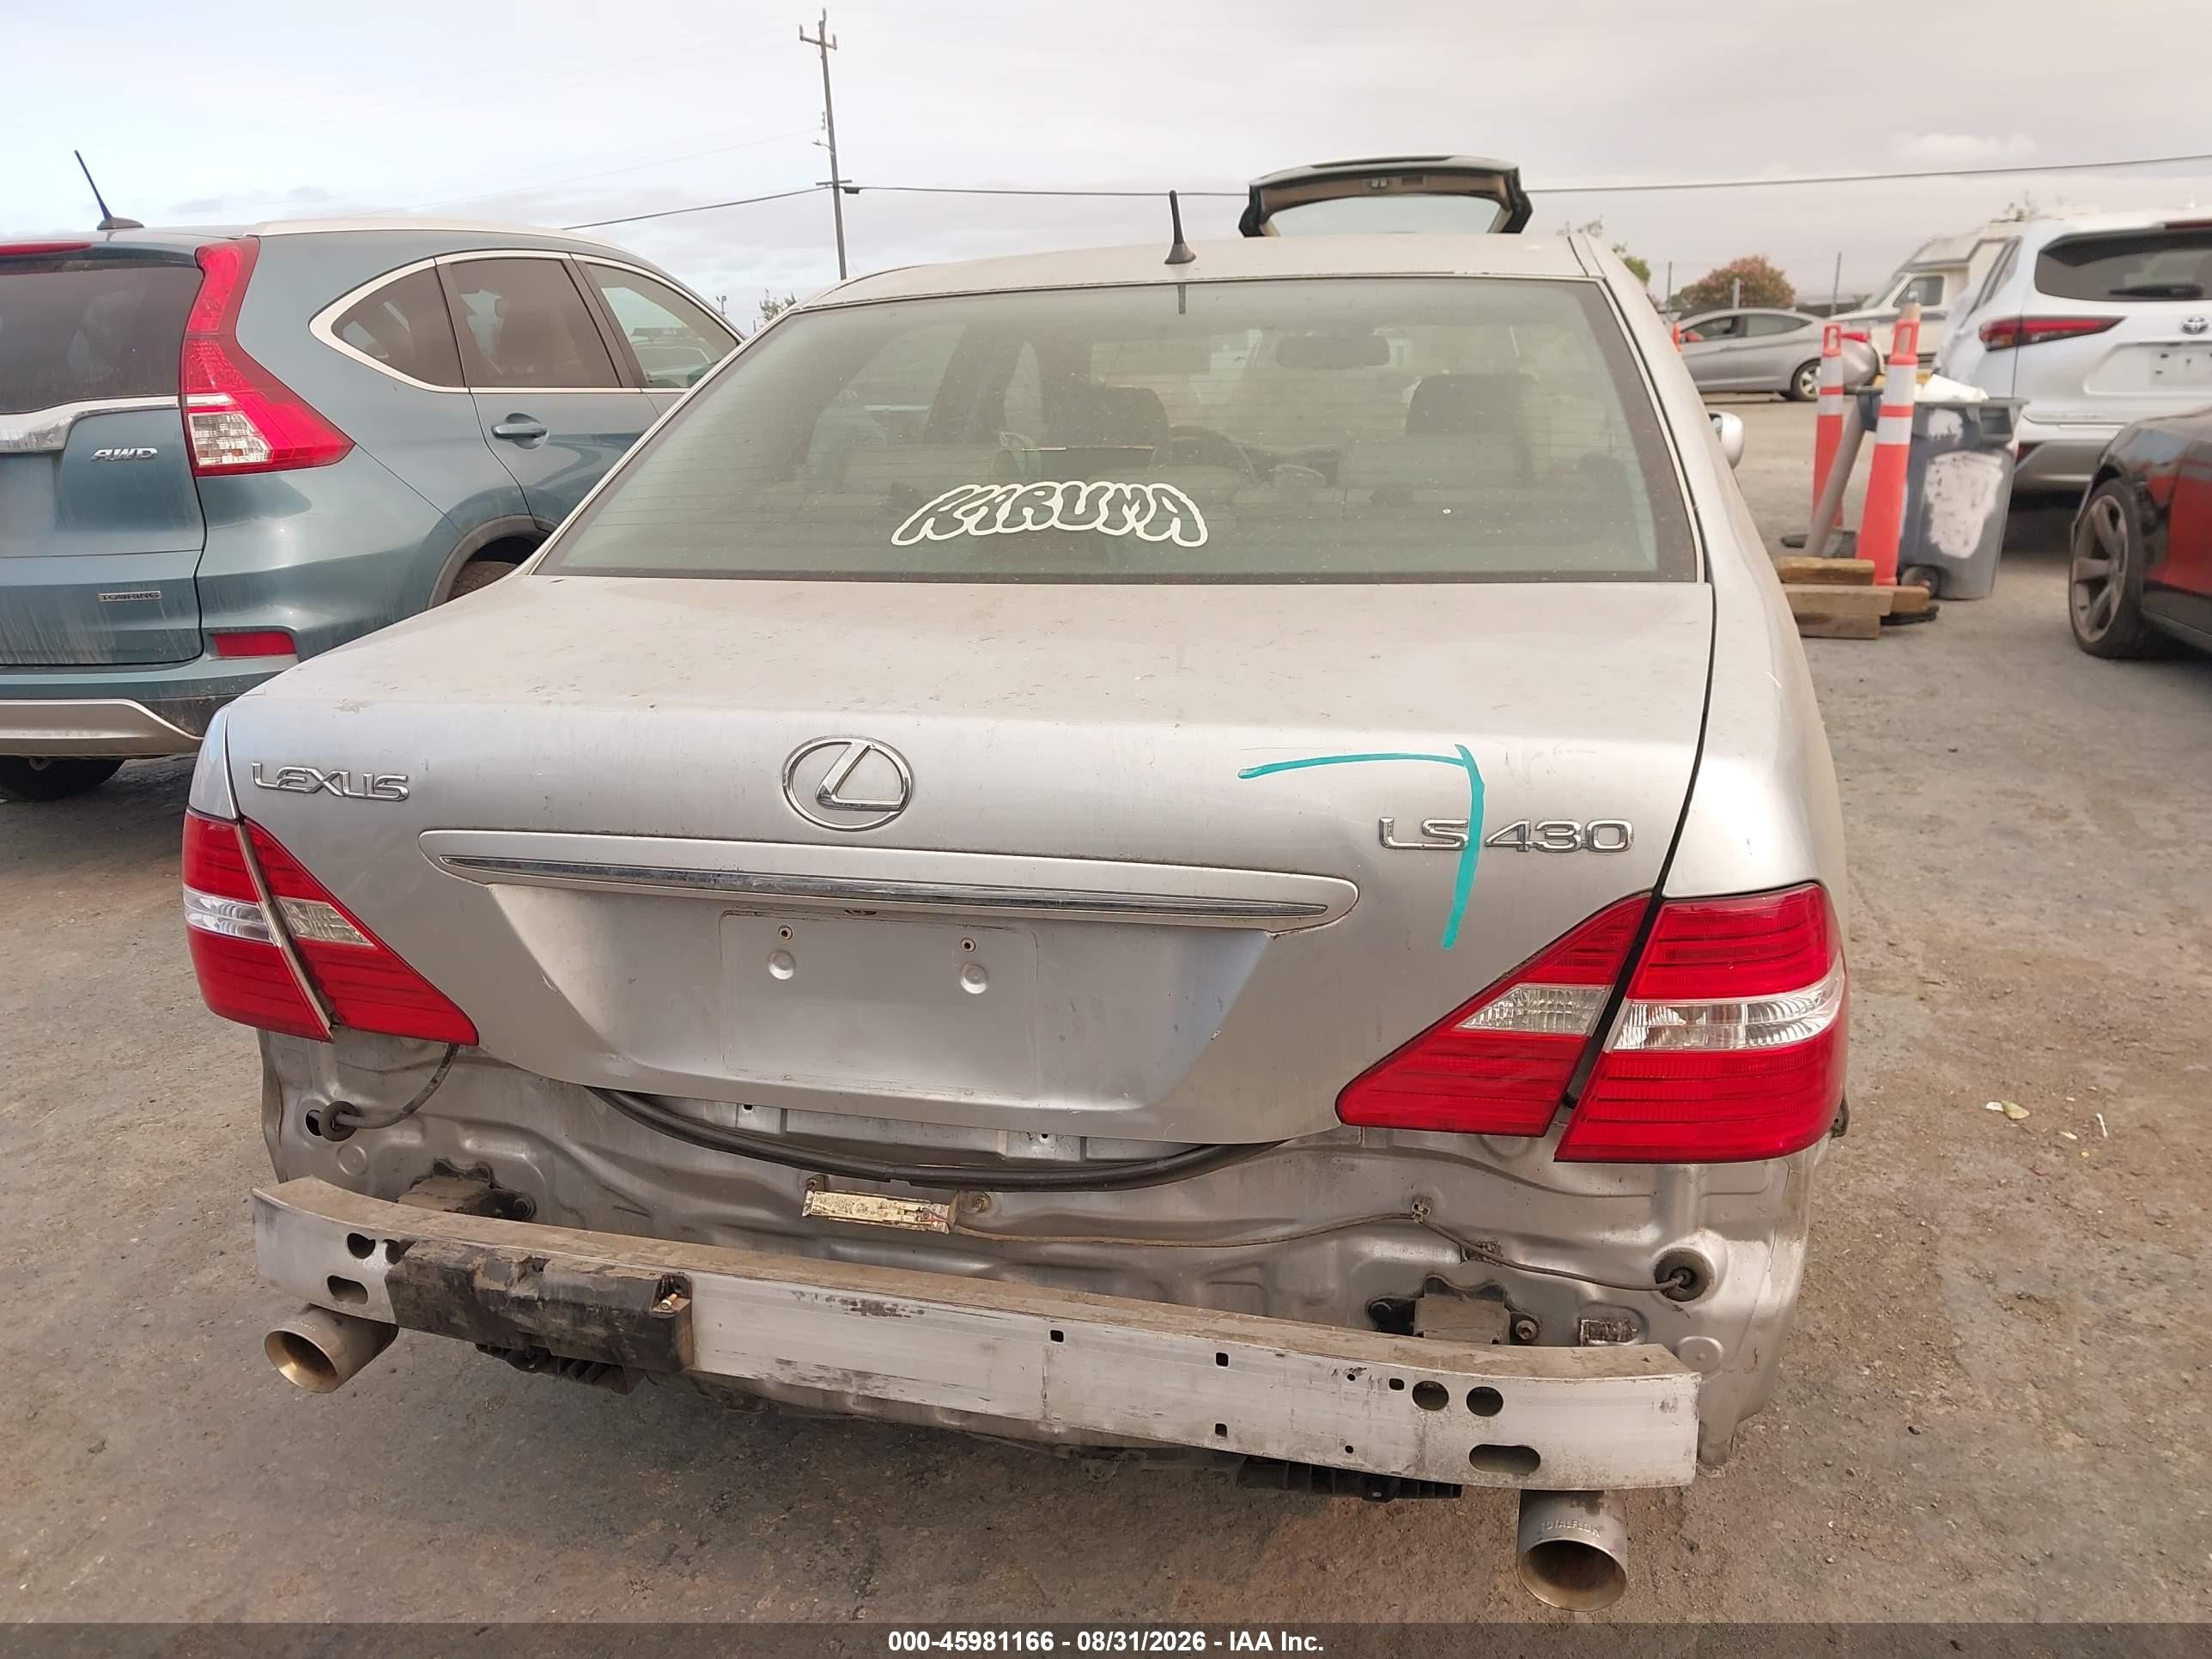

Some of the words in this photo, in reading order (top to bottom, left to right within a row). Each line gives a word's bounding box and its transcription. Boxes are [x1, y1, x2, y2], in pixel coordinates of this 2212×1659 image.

[90, 447, 158, 461] AWD
[890, 480, 1209, 548] KARUMA
[101, 592, 161, 600] TOURING
[252, 762, 410, 802] LEXUS
[1378, 817, 1469, 851] LS
[1483, 818, 1635, 853] 430
